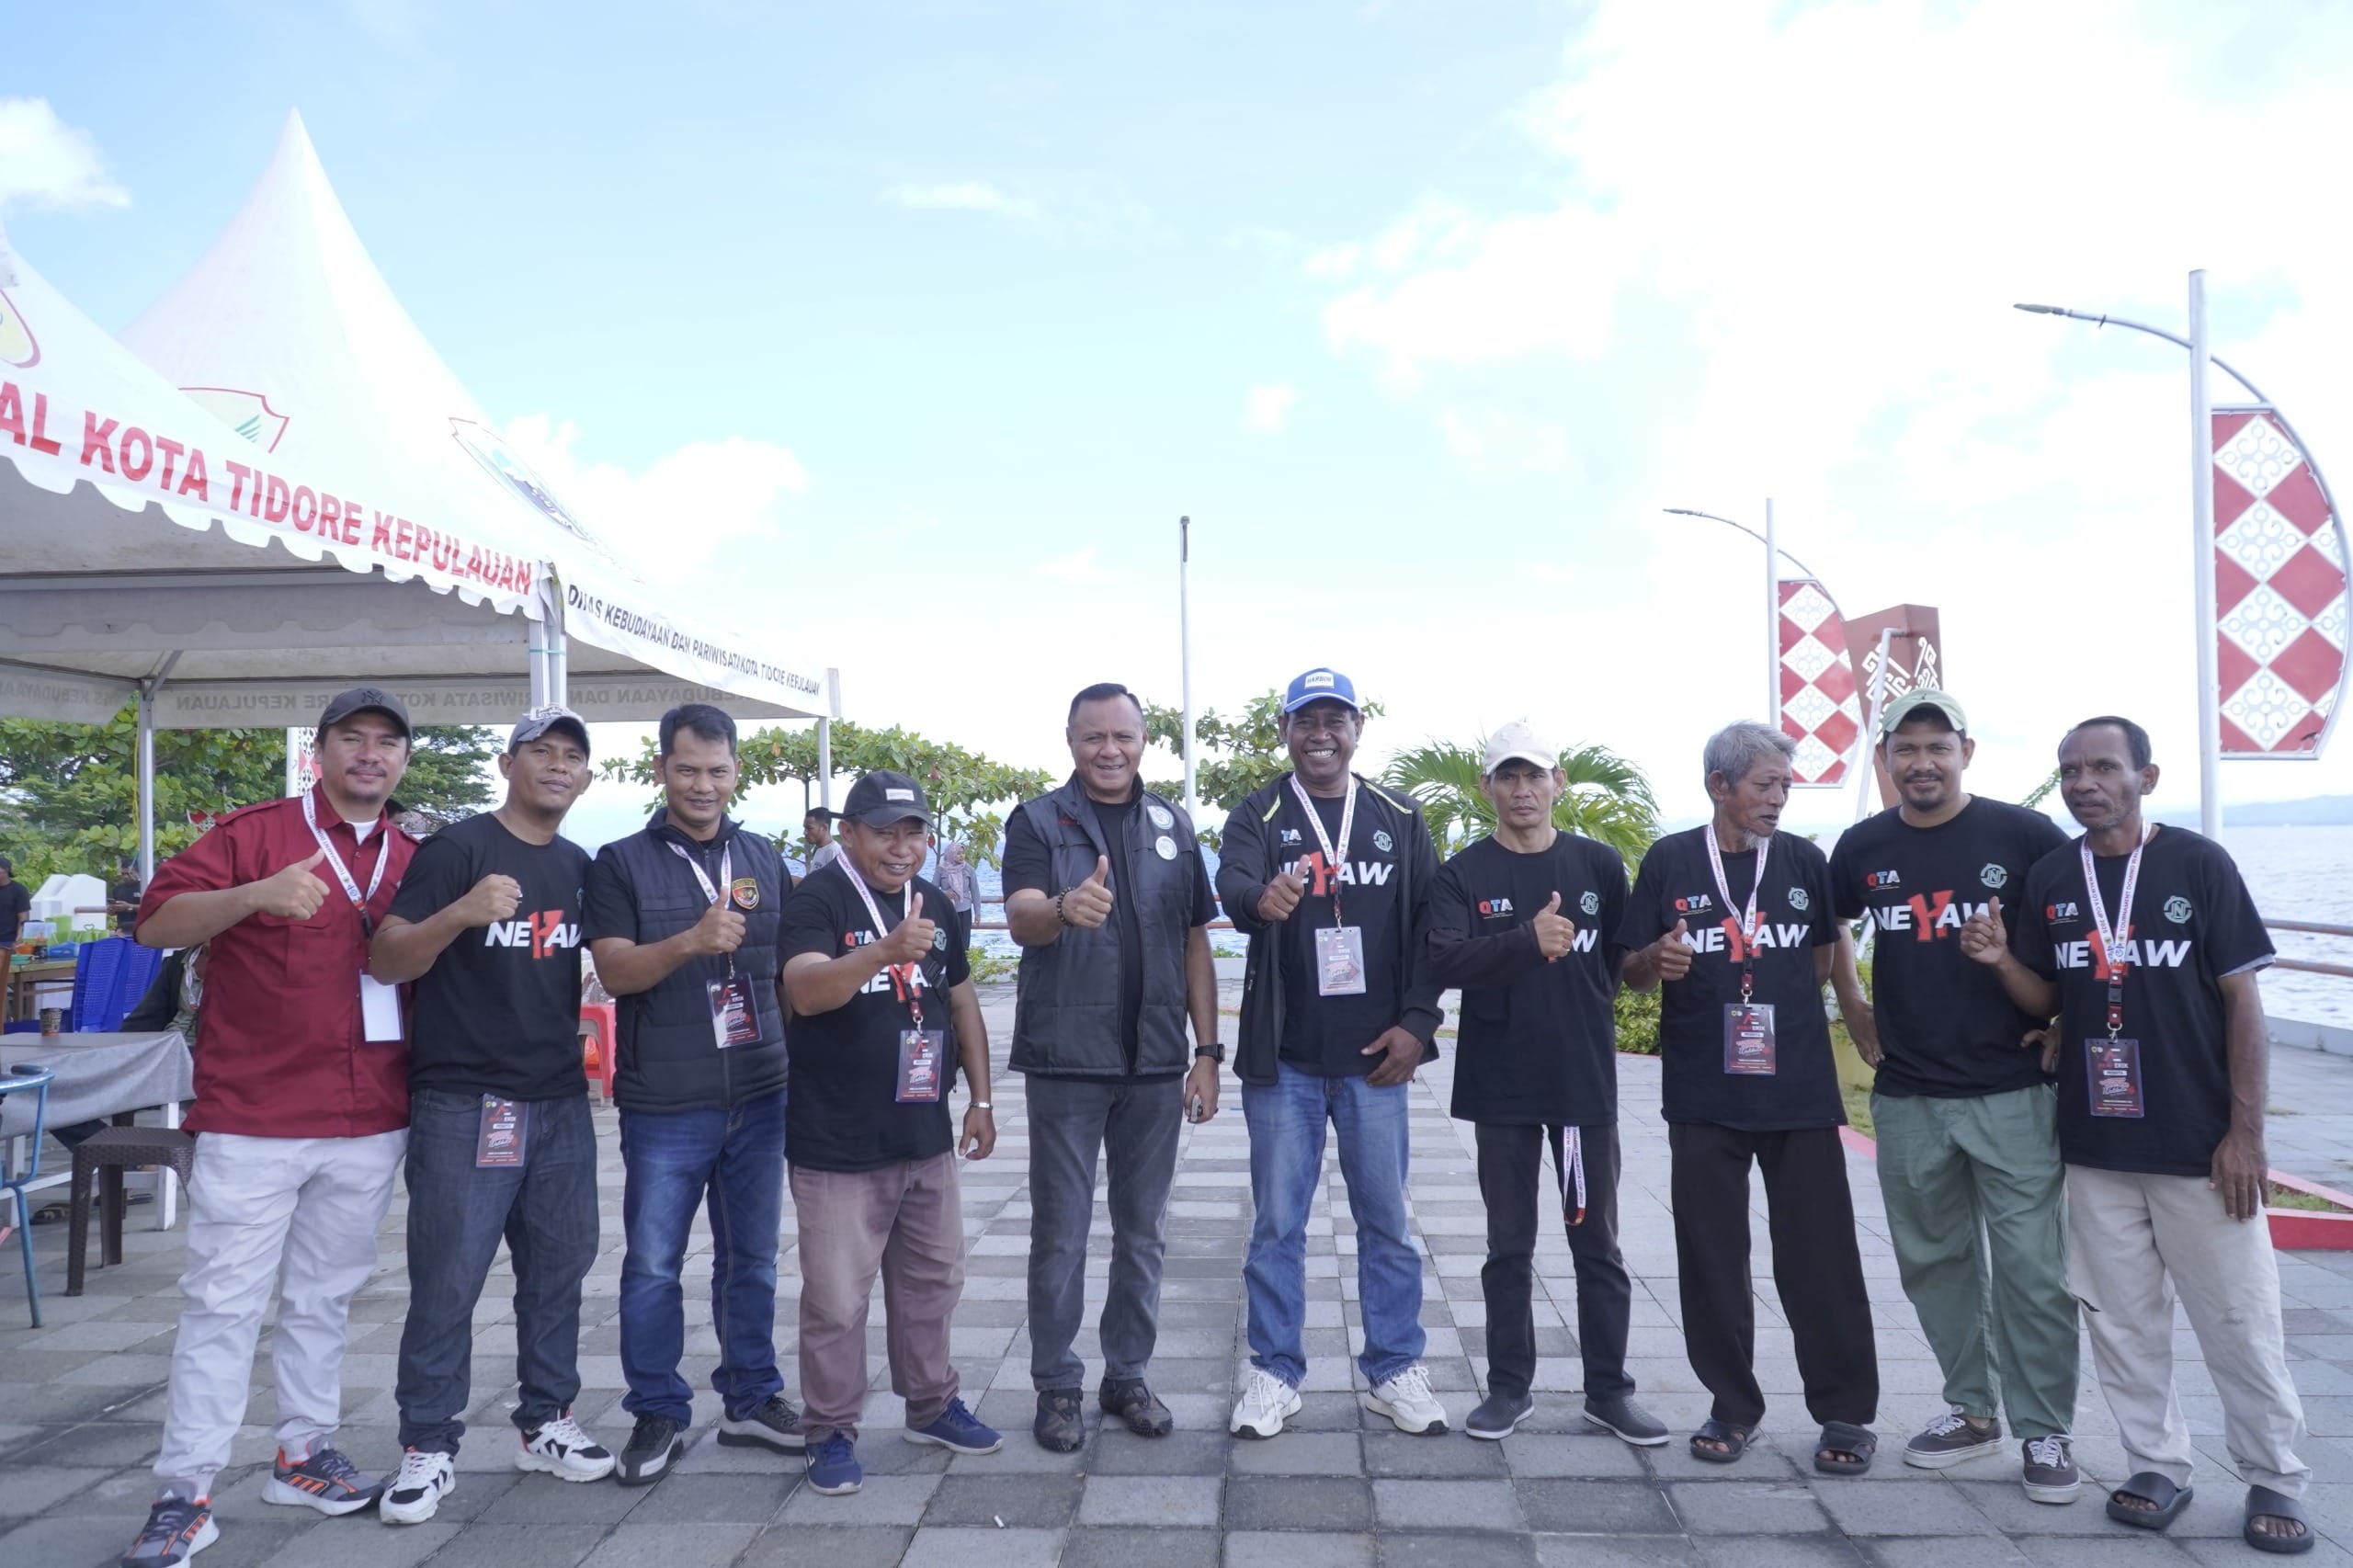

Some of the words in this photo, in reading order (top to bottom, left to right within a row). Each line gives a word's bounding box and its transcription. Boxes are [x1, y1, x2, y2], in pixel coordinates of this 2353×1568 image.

[81, 410, 208, 502] KOTA
[226, 460, 362, 547] TIDORE
[371, 510, 531, 596] KEPULAUAN
[604, 603, 670, 648] KEBUDAYAAN
[671, 631, 691, 654] DAN
[692, 639, 740, 671] PARIWISATA
[740, 658, 758, 677] KOTA
[1280, 829, 1302, 842] TA
[2083, 852, 2094, 875] DOMINO
[1867, 869, 1901, 887] QTA
[2088, 876, 2100, 906] WALIKOTA
[2117, 890, 2132, 931] TOURNAMENT
[2125, 864, 2135, 890] DOMINO
[1478, 897, 1514, 915] QTA
[1675, 893, 1712, 912] QTA
[2046, 902, 2079, 920] QTA
